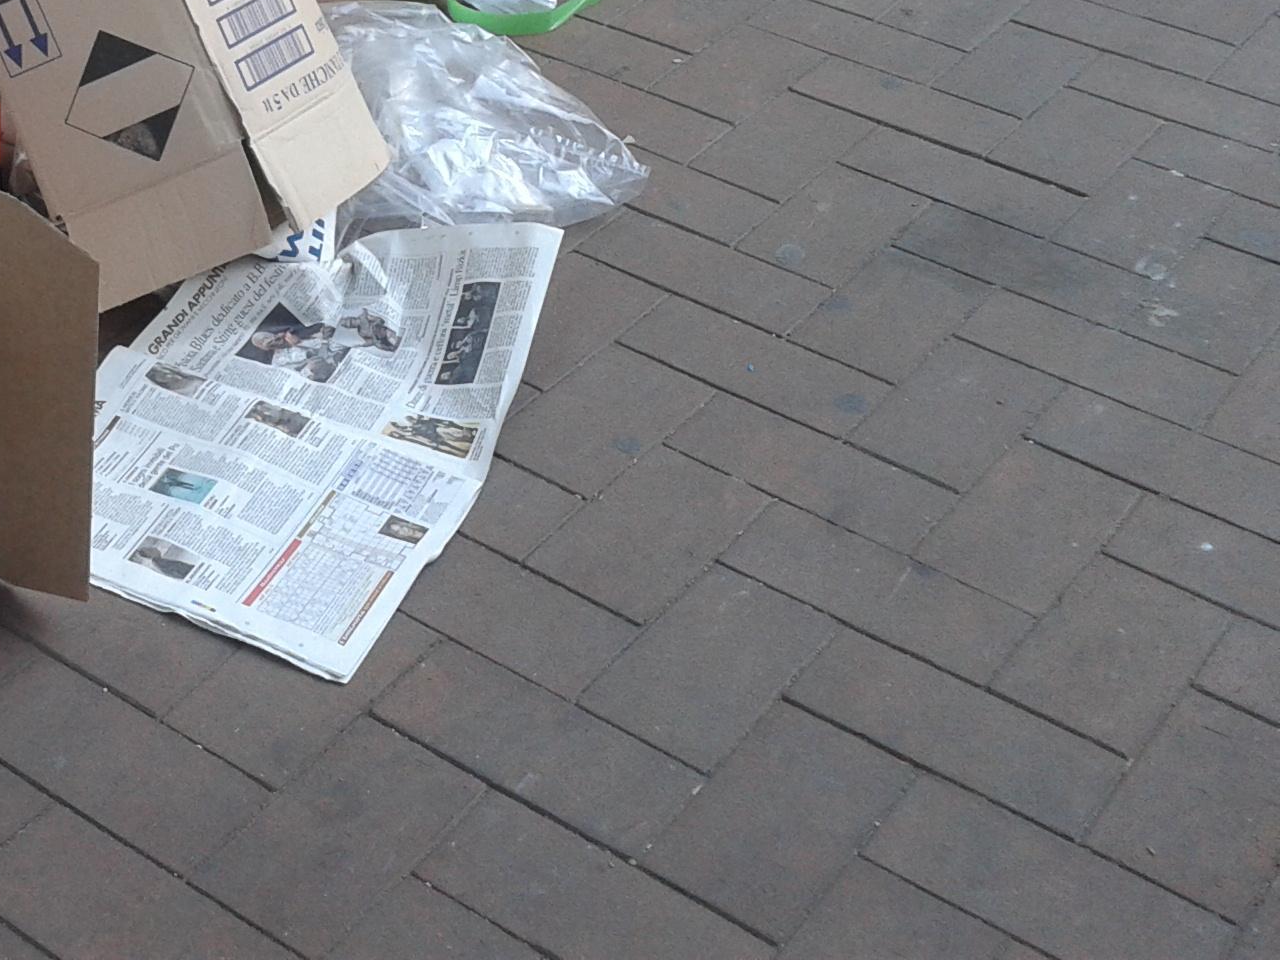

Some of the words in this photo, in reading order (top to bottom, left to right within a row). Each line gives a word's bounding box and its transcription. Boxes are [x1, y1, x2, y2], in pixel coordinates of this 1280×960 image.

[271, 92, 283, 110] 5
[280, 82, 299, 102] DA
[252, 283, 267, 301] del
[148, 308, 188, 354] GRANDI
[188, 262, 226, 312] APPUNT
